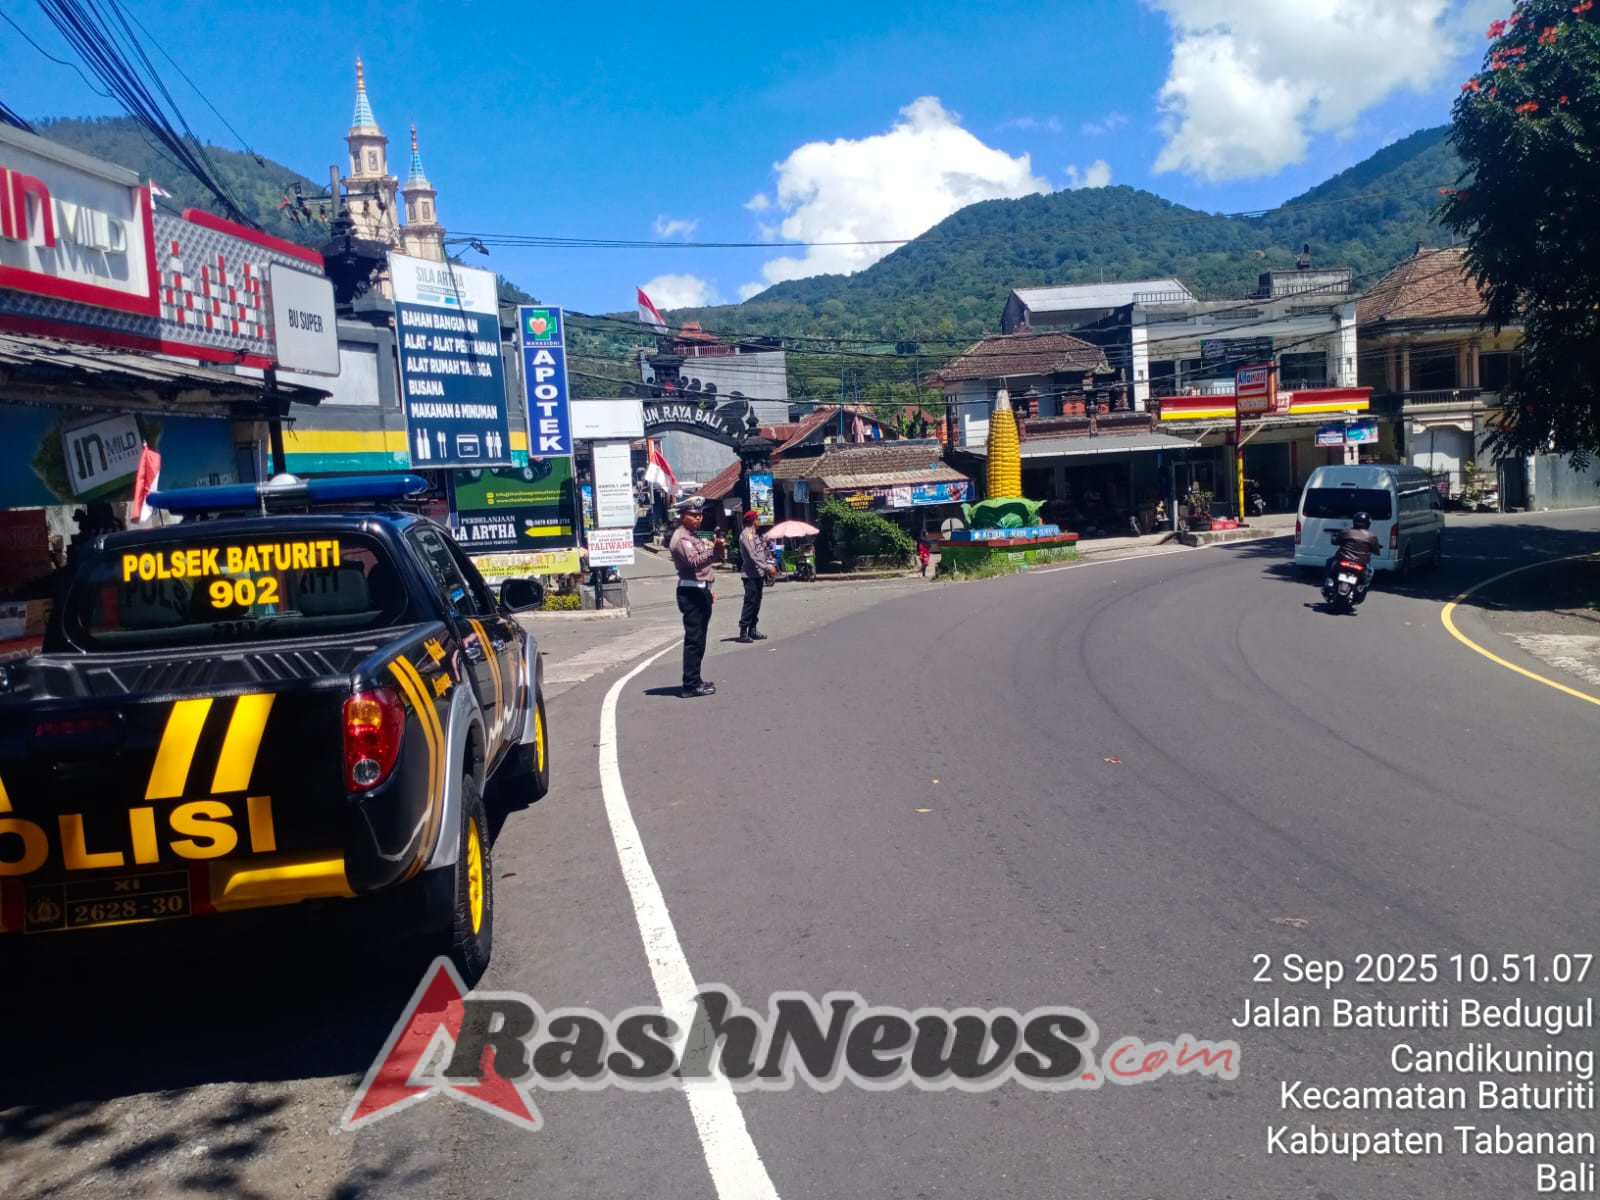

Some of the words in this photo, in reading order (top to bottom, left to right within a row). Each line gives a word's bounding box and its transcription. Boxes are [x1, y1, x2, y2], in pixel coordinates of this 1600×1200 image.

[416, 266, 435, 284] SILA
[289, 308, 299, 328] BU
[300, 310, 323, 334] SUPER
[401, 310, 433, 328] BAHAN
[404, 333, 427, 350] ALAT
[433, 336, 454, 353] ALAT
[407, 357, 429, 373] ALAT
[429, 358, 460, 375] RUMAH
[408, 379, 445, 396] BUSANA
[531, 350, 564, 452] APOTEK
[411, 402, 454, 419] MAKANAN
[461, 403, 498, 420] MINUMAN
[662, 405, 692, 419] RAYA
[695, 409, 723, 429] BALI
[472, 523, 517, 540] ARTHA
[122, 548, 221, 582] POLSEK
[226, 540, 341, 574] BATURITI
[208, 576, 280, 608] 902
[113, 879, 141, 892] XI
